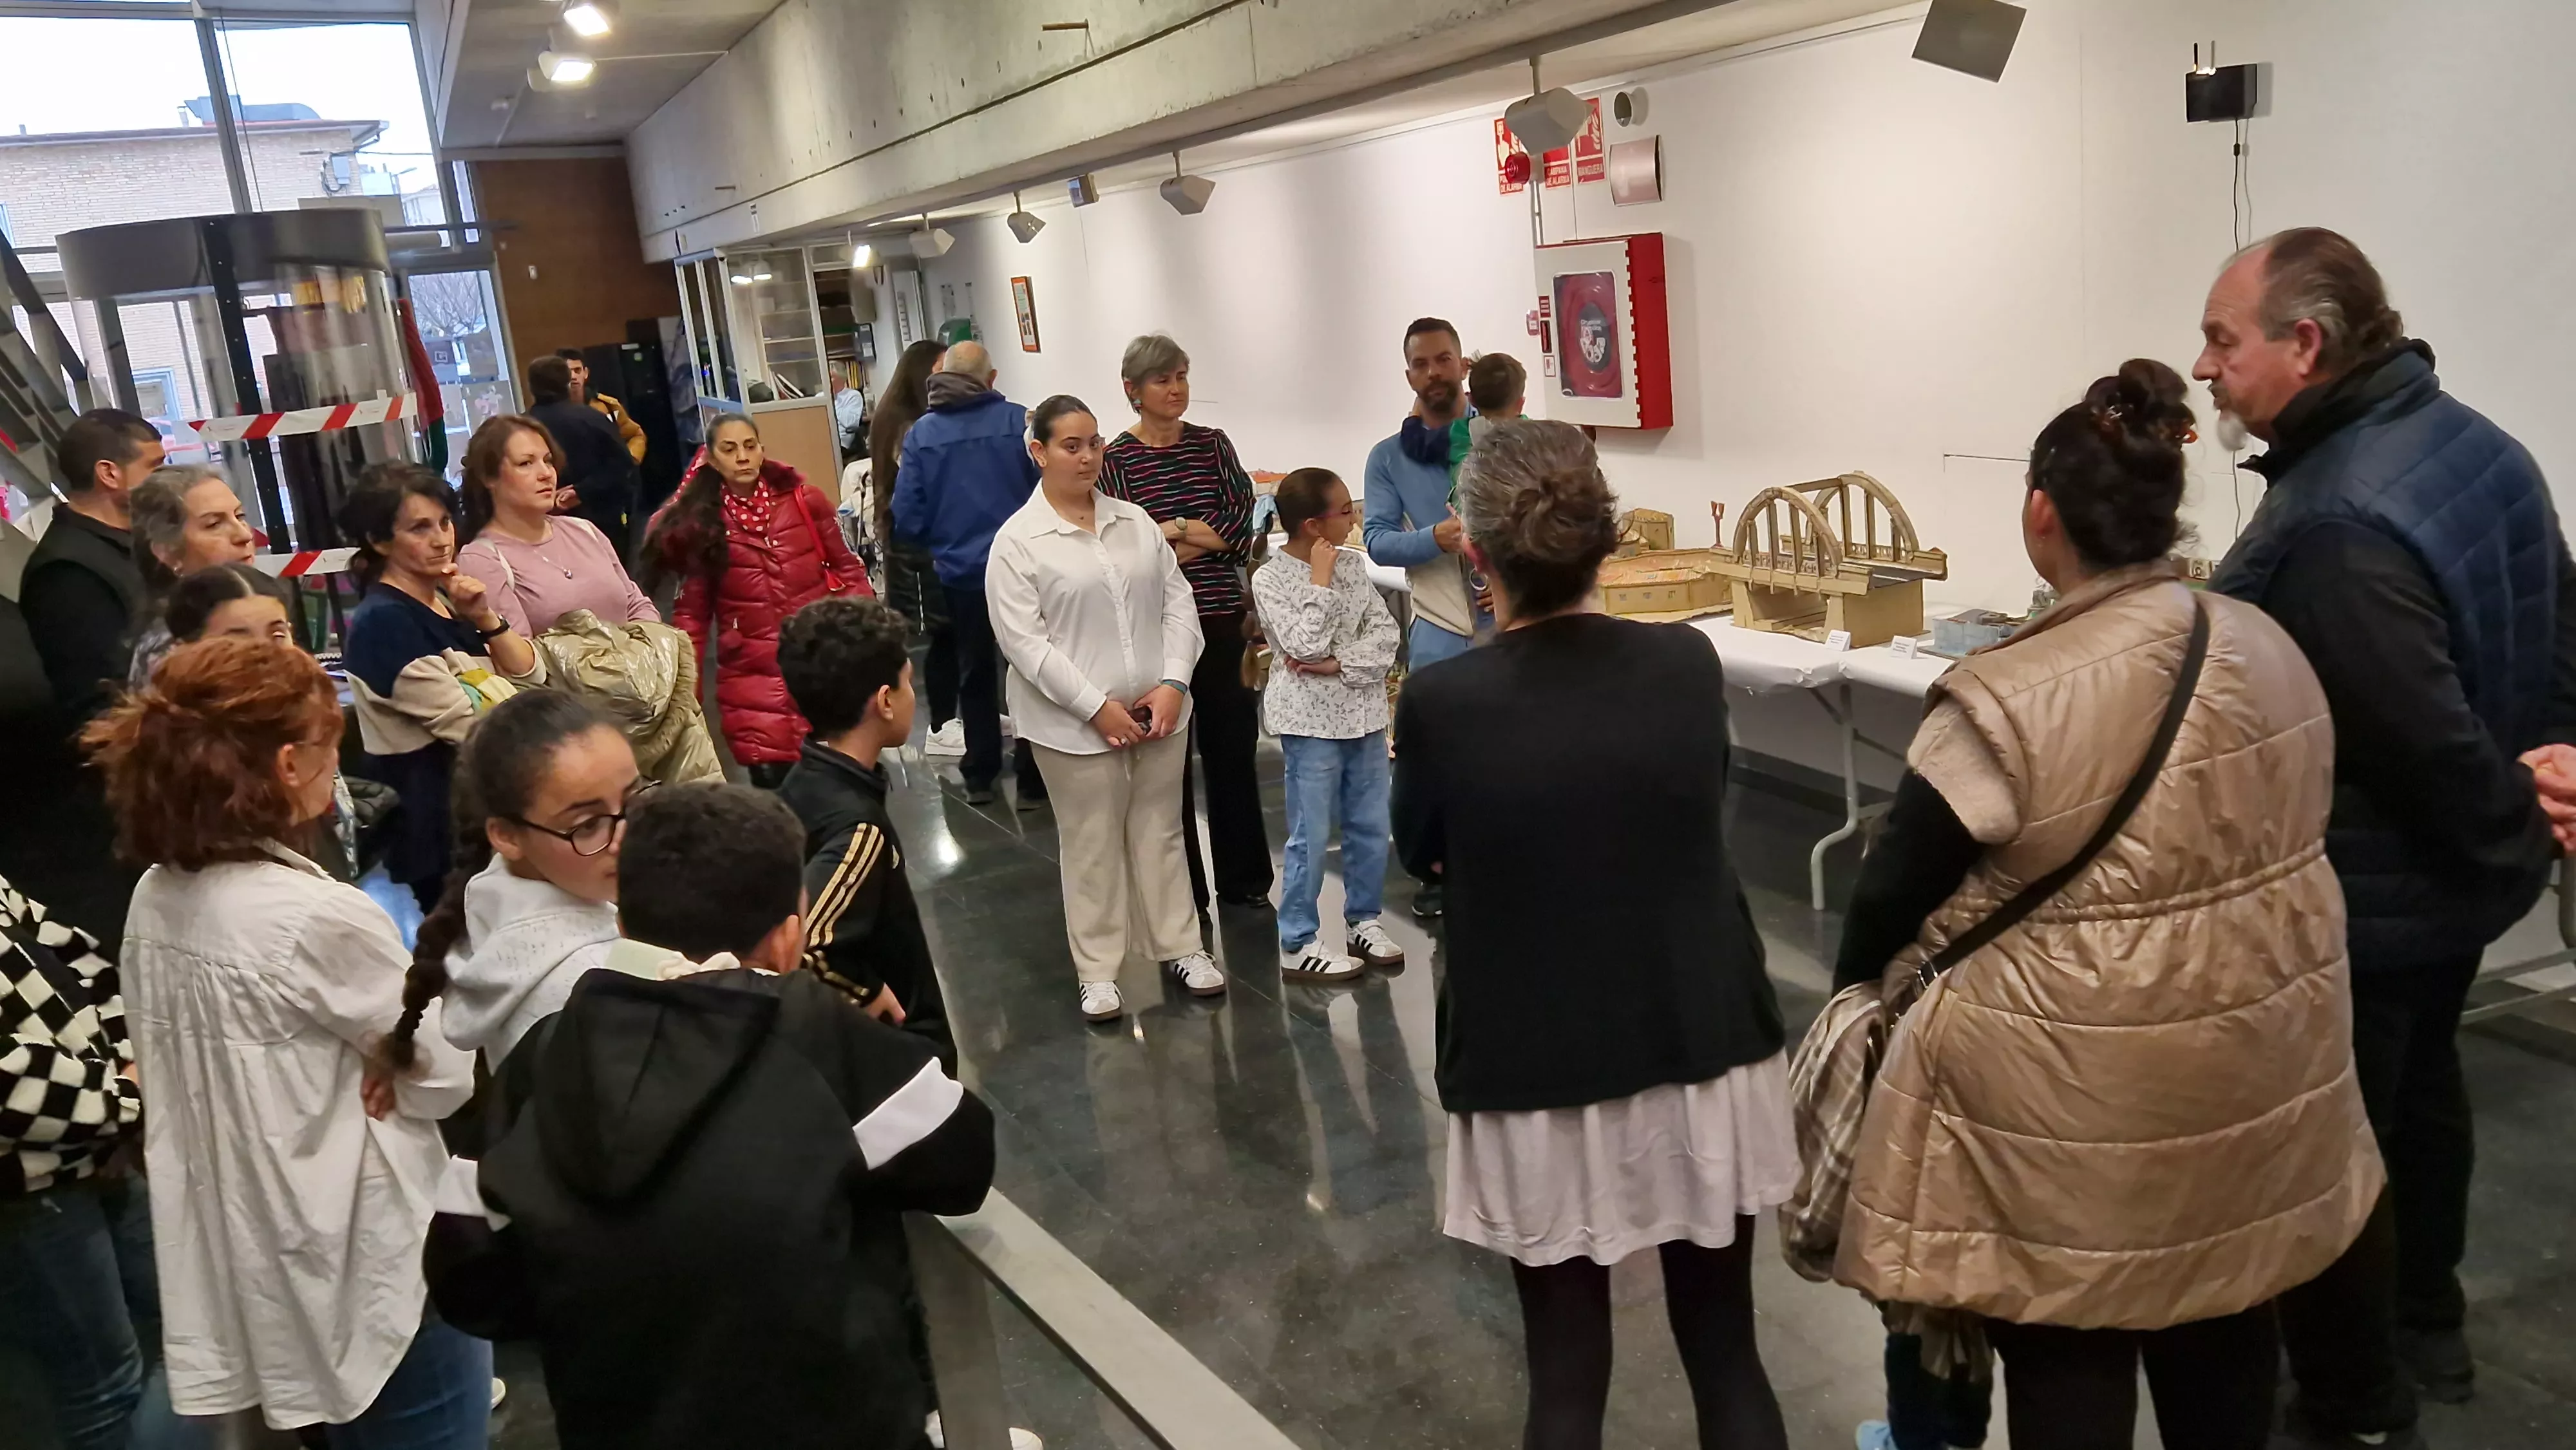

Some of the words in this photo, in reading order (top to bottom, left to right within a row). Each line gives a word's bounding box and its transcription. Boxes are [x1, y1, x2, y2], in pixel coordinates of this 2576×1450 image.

[1546, 166, 1567, 175] CAMPANA
[1578, 164, 1604, 176] MANGUERA
[1553, 176, 1569, 185] ALARMA
